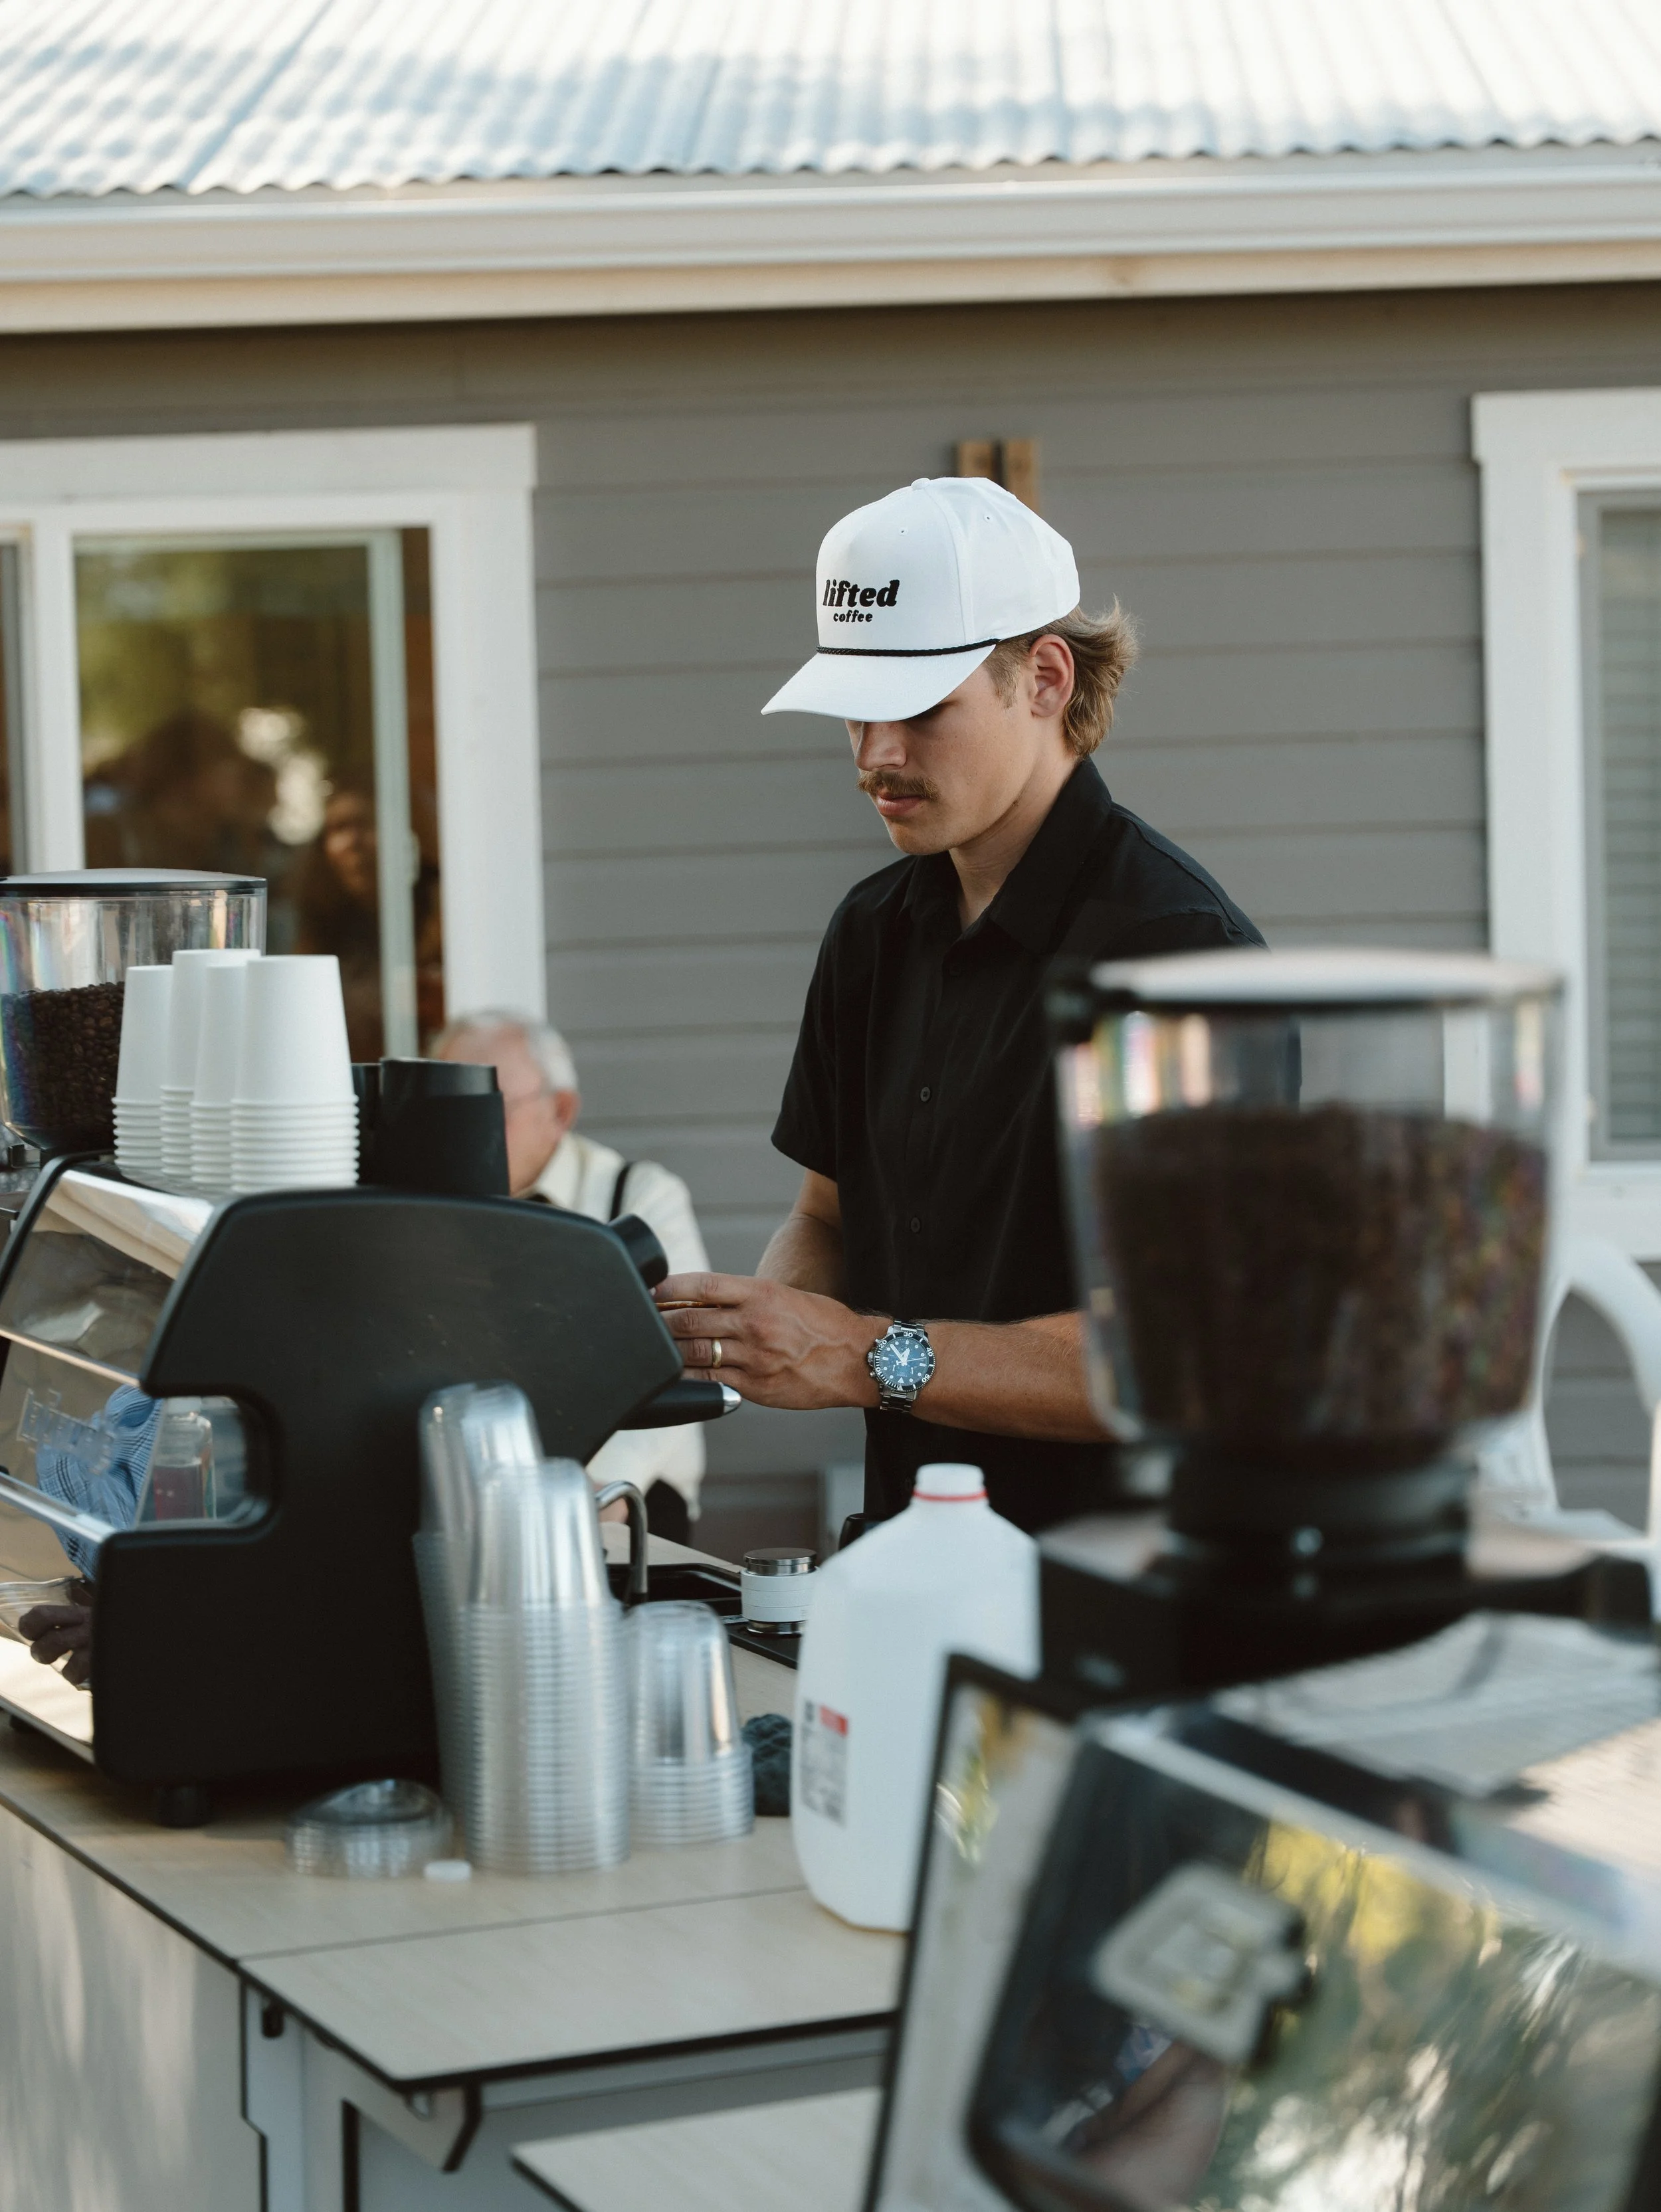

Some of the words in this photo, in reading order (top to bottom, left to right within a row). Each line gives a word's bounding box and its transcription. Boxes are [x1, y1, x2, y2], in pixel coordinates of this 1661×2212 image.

[823, 579, 900, 607] lifted
[833, 610, 873, 622] coffee
[880, 1340, 888, 1348] 20
[926, 1347, 933, 1356] 40
[876, 1367, 882, 1376] 10
[922, 1373, 931, 1382] 50
